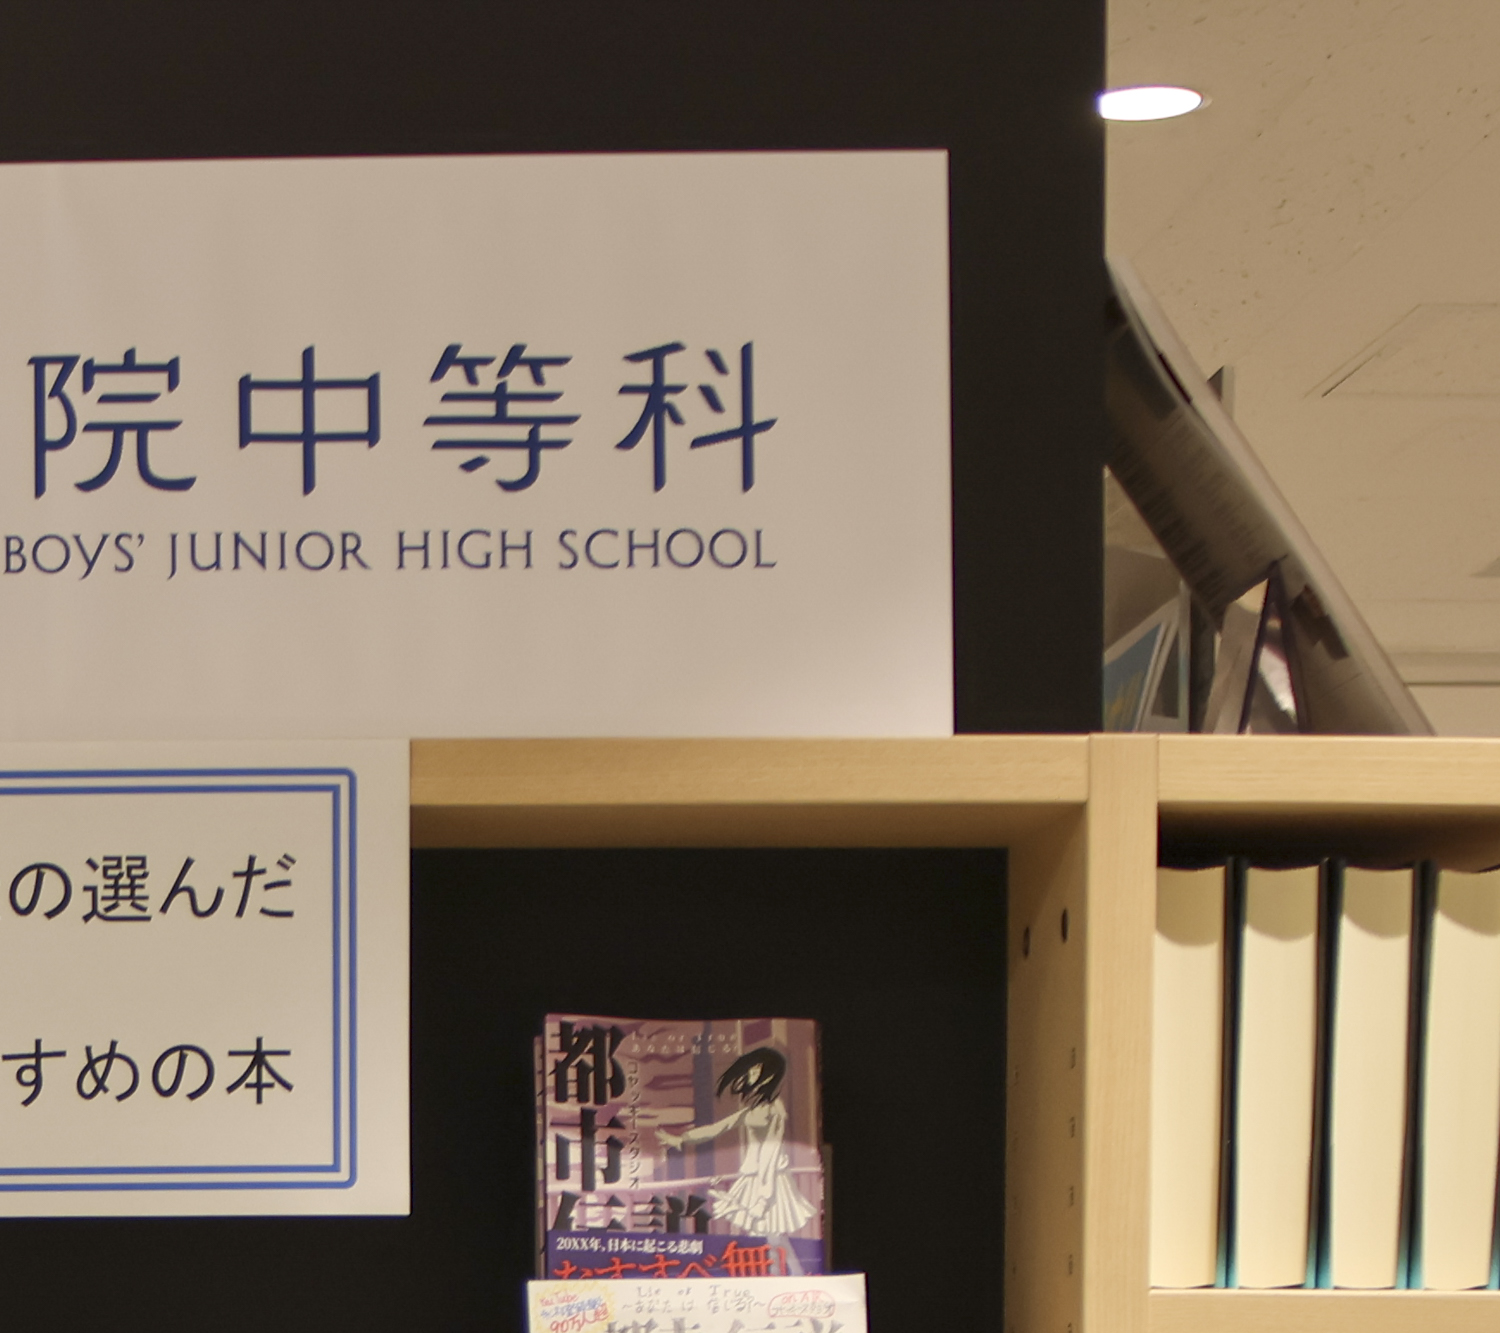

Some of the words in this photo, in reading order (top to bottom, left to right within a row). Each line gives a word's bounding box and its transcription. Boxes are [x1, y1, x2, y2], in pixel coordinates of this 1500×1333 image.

[168, 529, 371, 580] JUNIOR
[396, 528, 534, 573] HIGH
[556, 527, 777, 571] SCHOOL
[626, 1061, 642, 1190] コヤッキースタジオ
